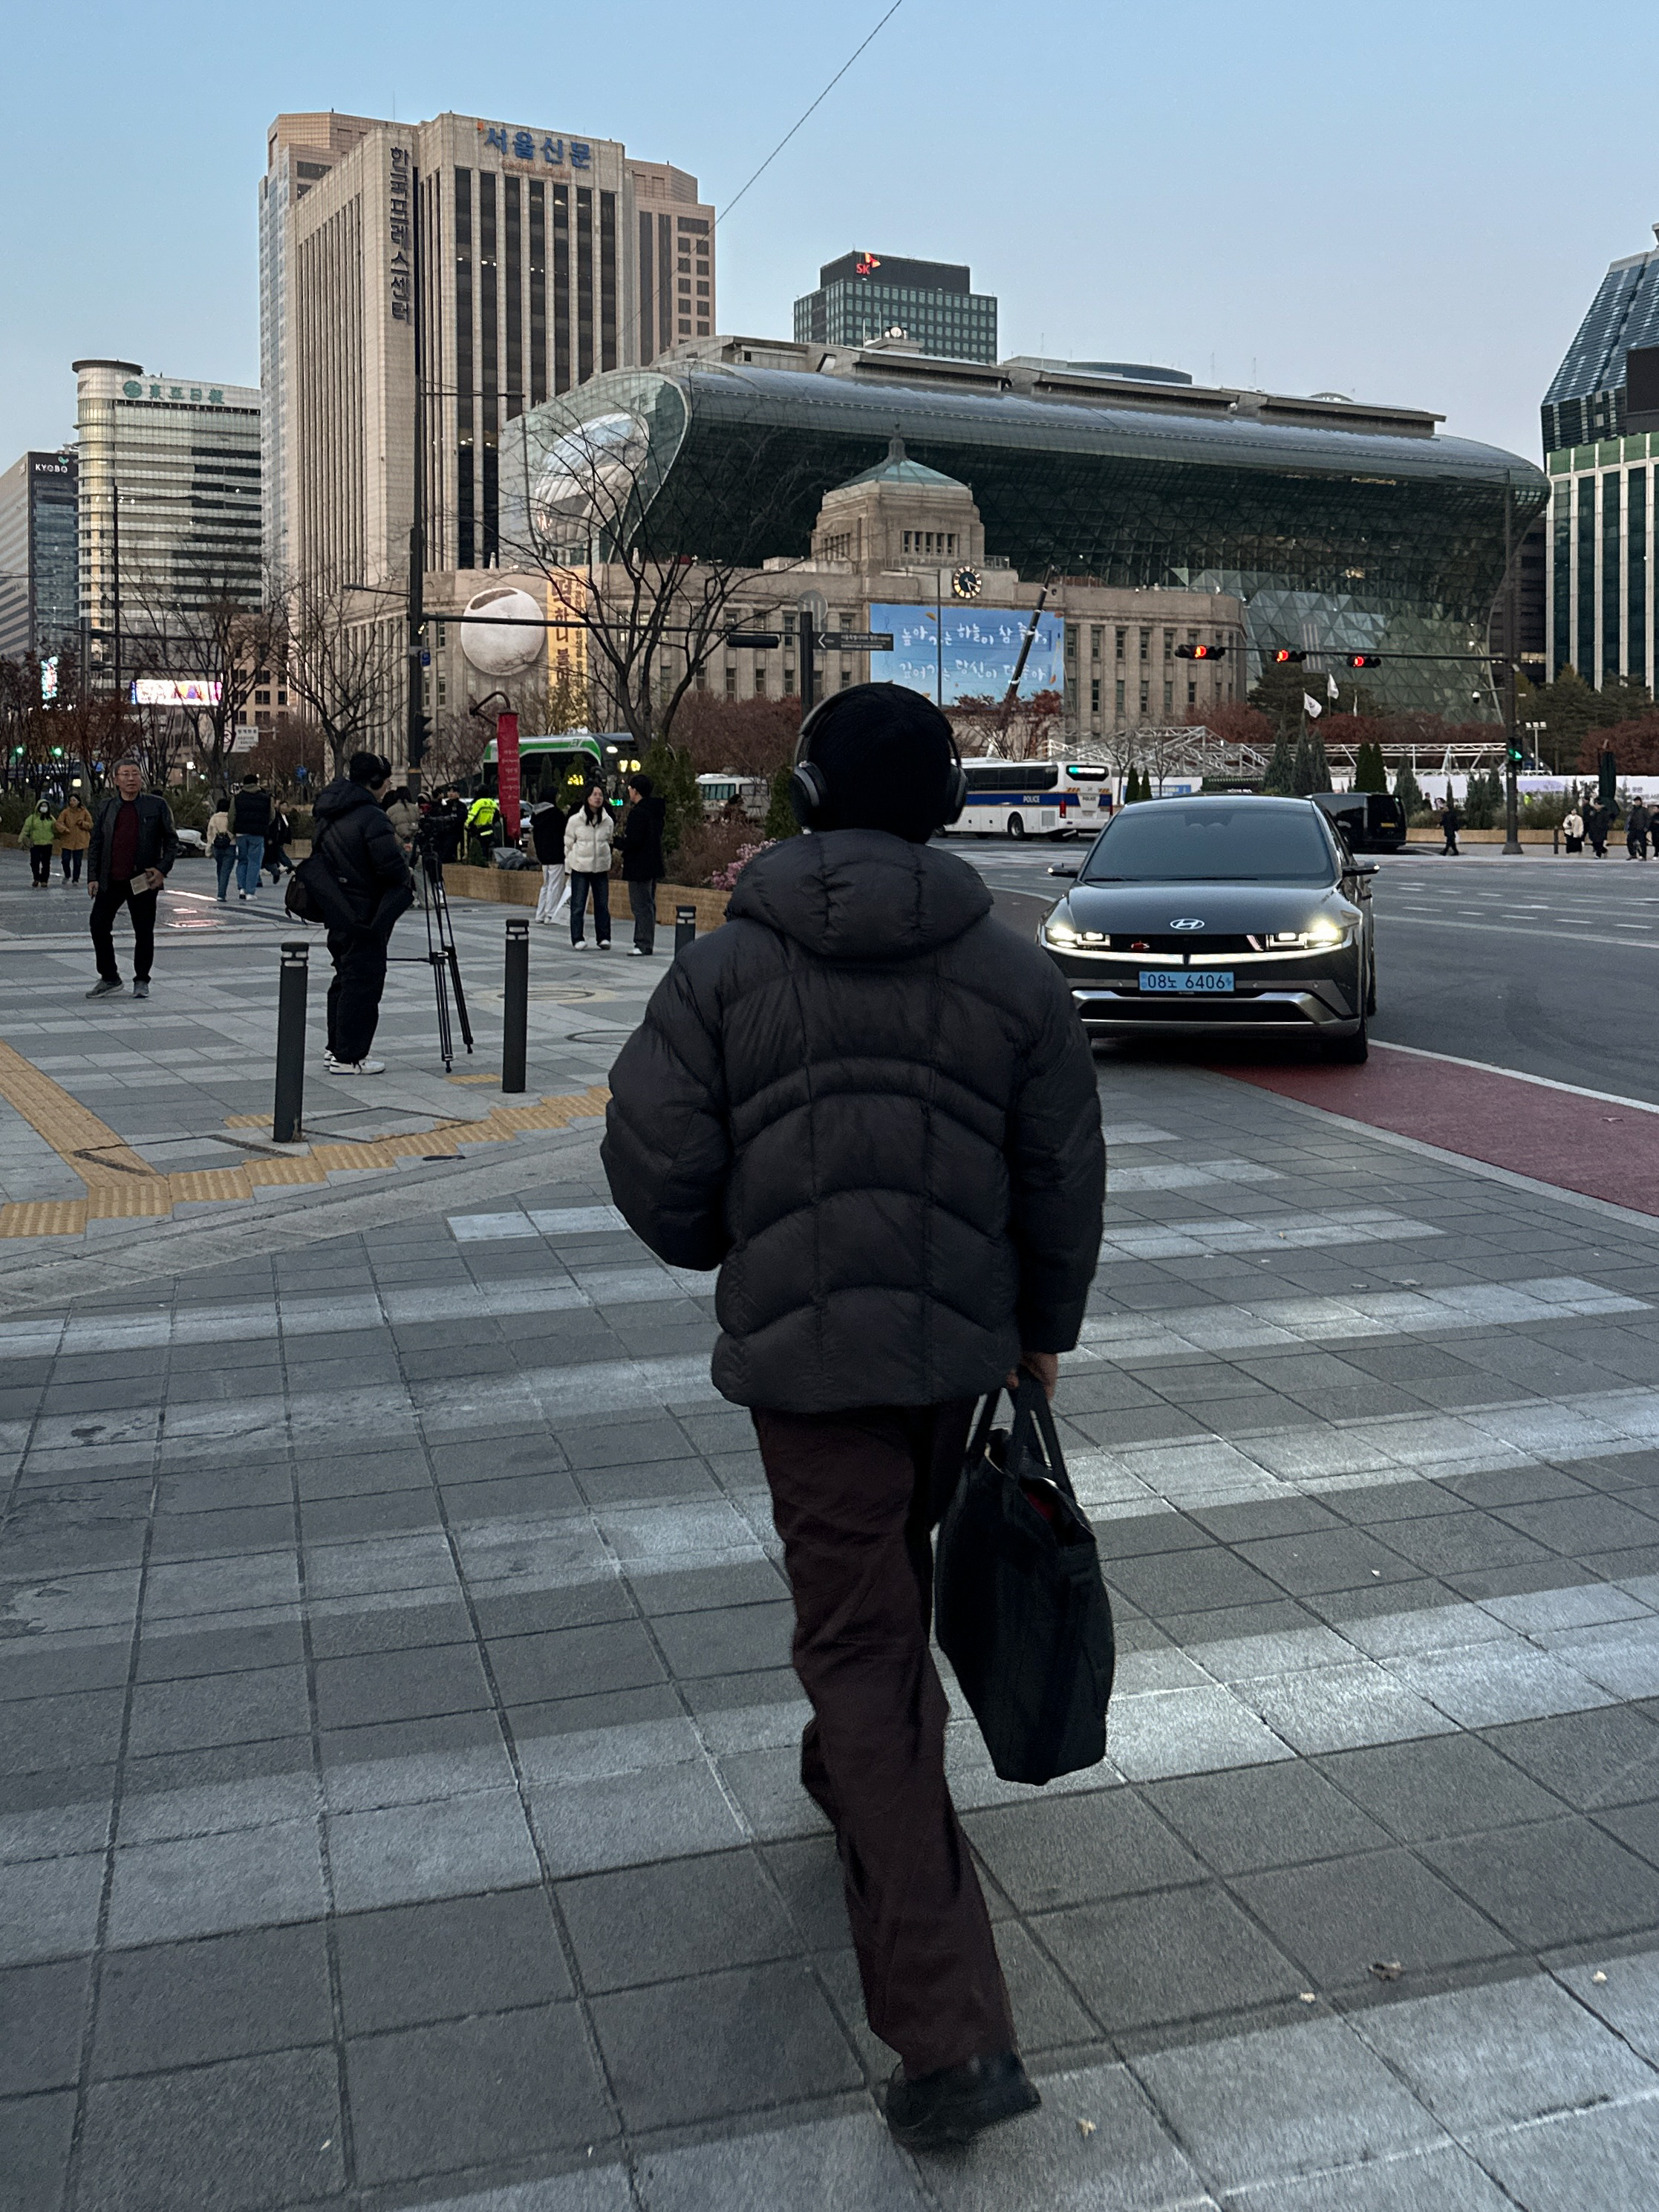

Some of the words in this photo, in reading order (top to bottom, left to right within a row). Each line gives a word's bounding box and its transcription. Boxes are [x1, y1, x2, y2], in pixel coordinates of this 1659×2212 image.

[484, 128, 591, 170] 서울신문
[390, 146, 409, 325] 한국프레스센터
[855, 263, 870, 276] SK
[35, 463, 68, 474] KYOBO
[956, 622, 994, 645] 하늘이
[999, 625, 1013, 644] 참
[956, 659, 997, 678] 당신이
[1023, 795, 1040, 804] POLICE
[1147, 974, 1178, 989] 08노
[1185, 975, 1225, 989] 6406
